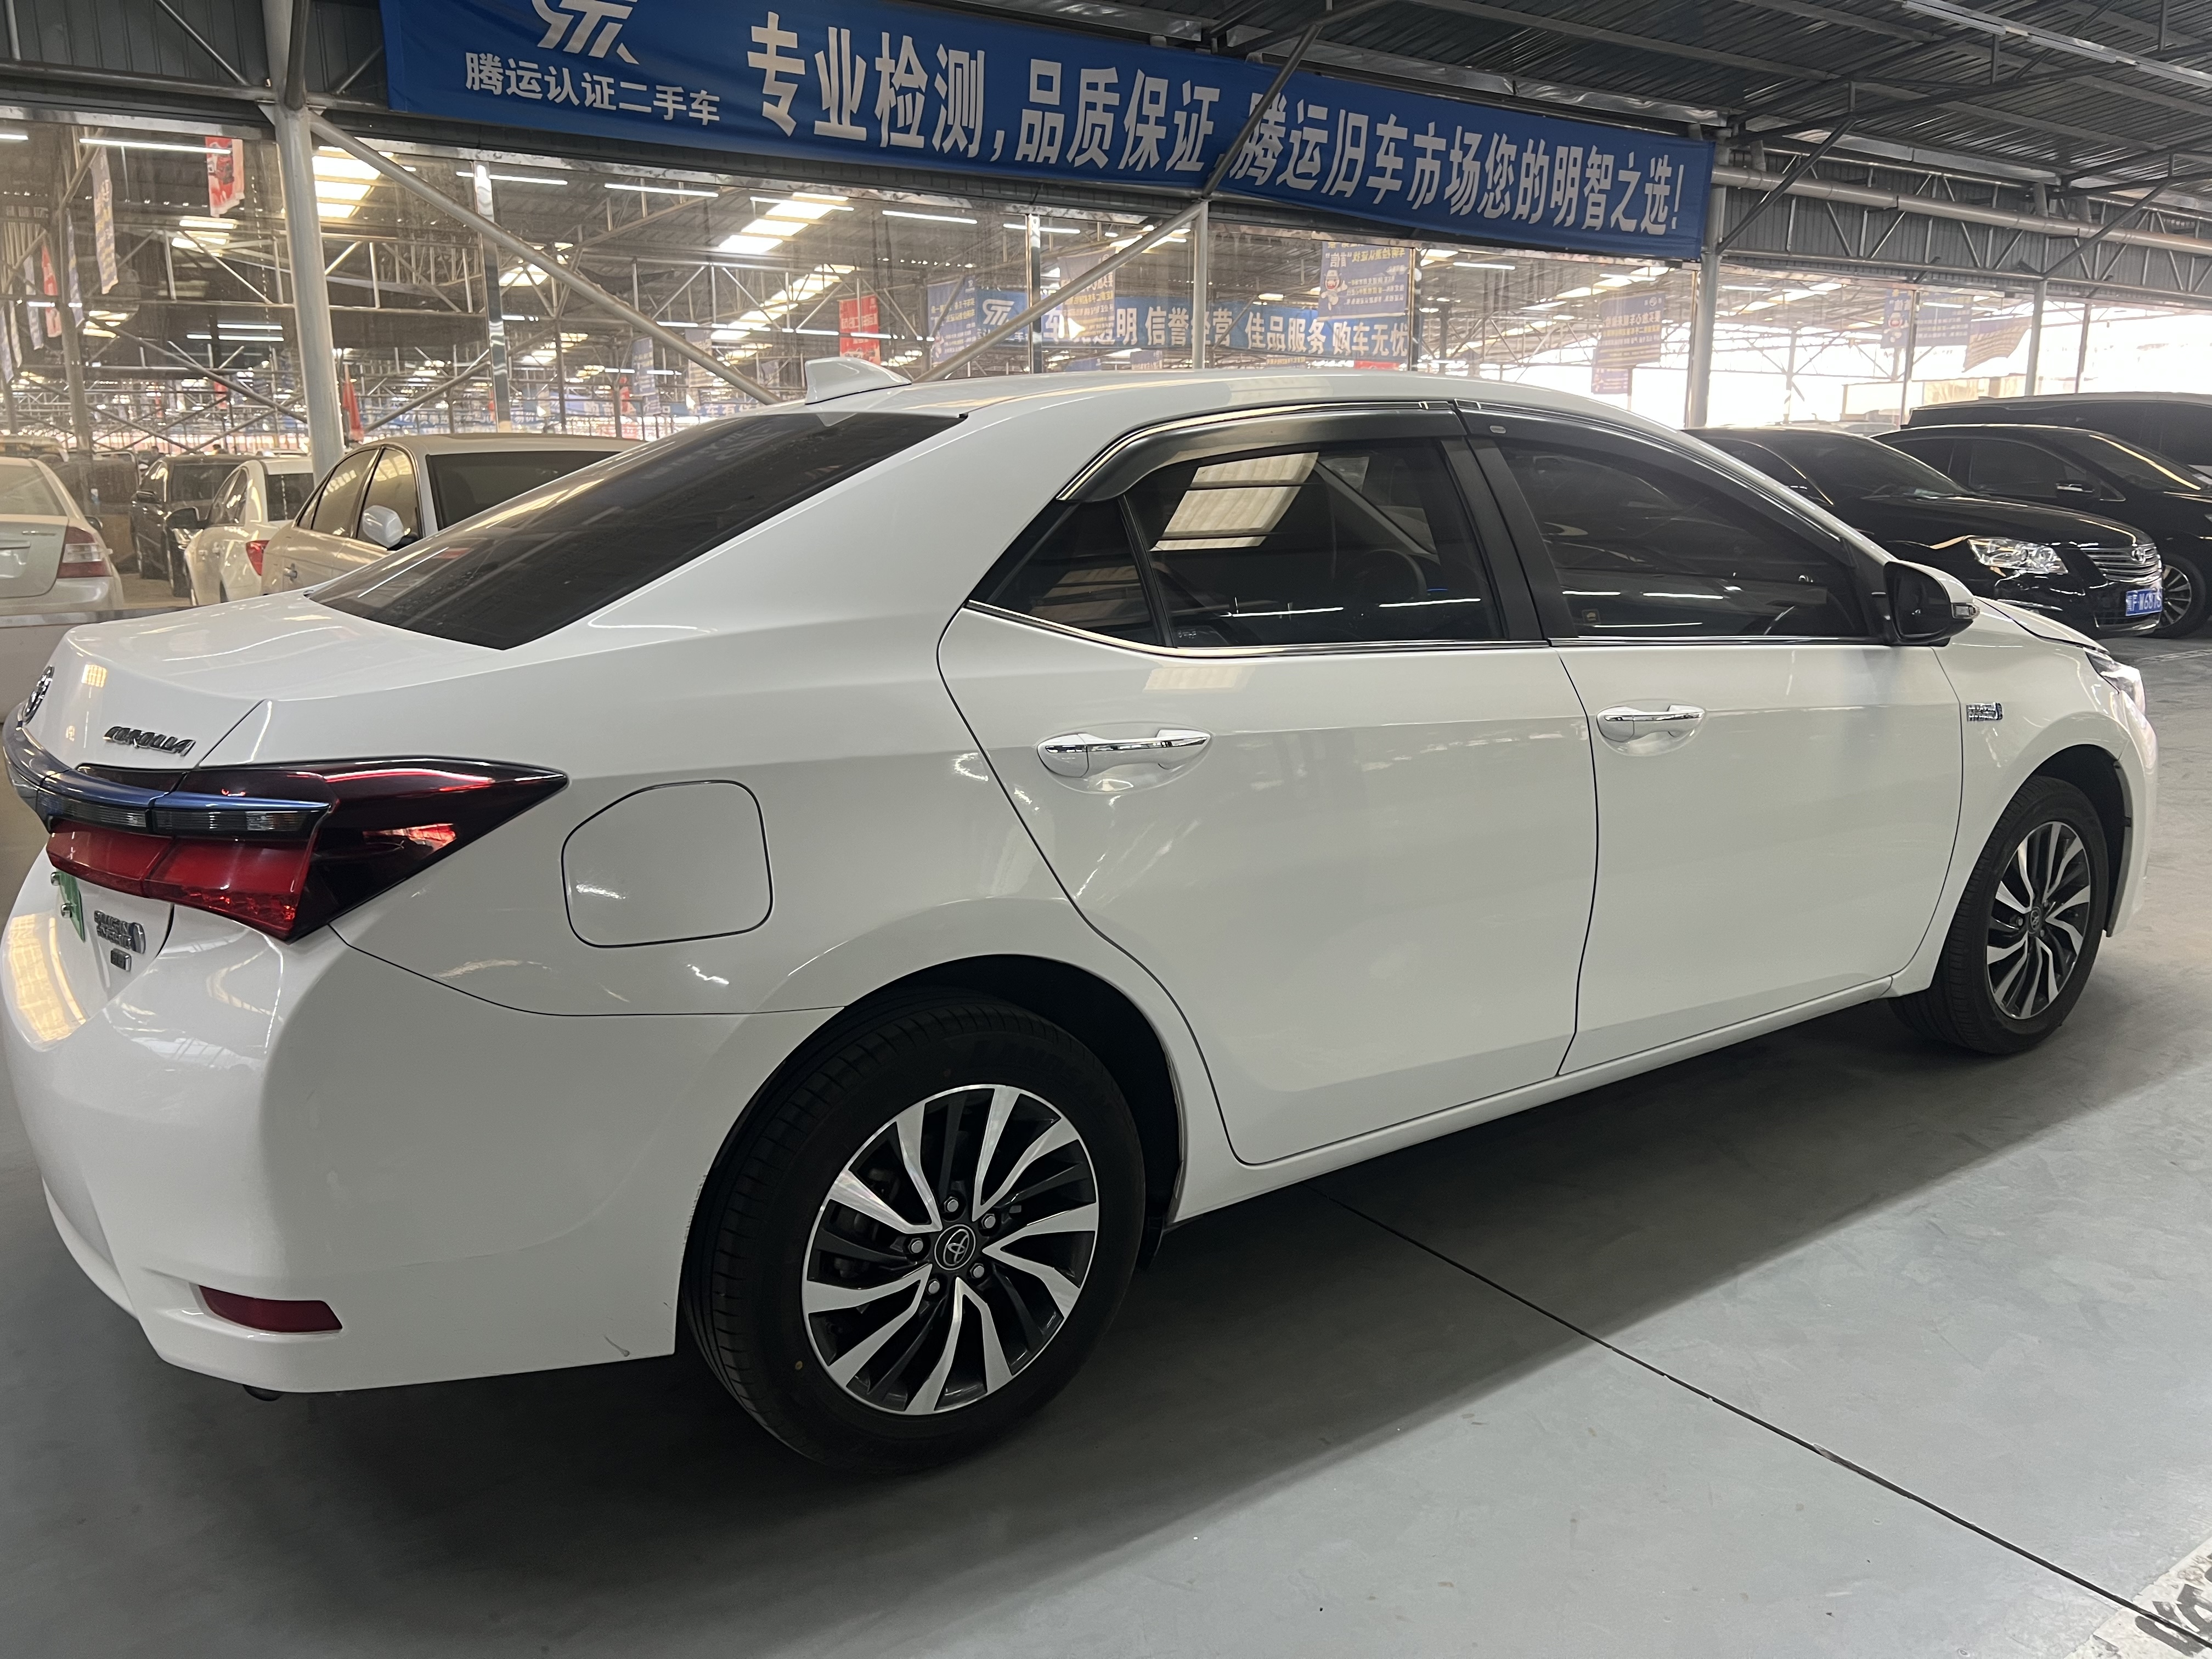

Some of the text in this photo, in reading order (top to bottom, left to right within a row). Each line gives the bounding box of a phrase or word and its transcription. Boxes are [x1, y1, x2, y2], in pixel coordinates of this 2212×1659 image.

[465, 52, 721, 126] 腾运认证二手车
[1245, 312, 1326, 355] 佳品服务
[1333, 321, 1408, 357] 购车无忧
